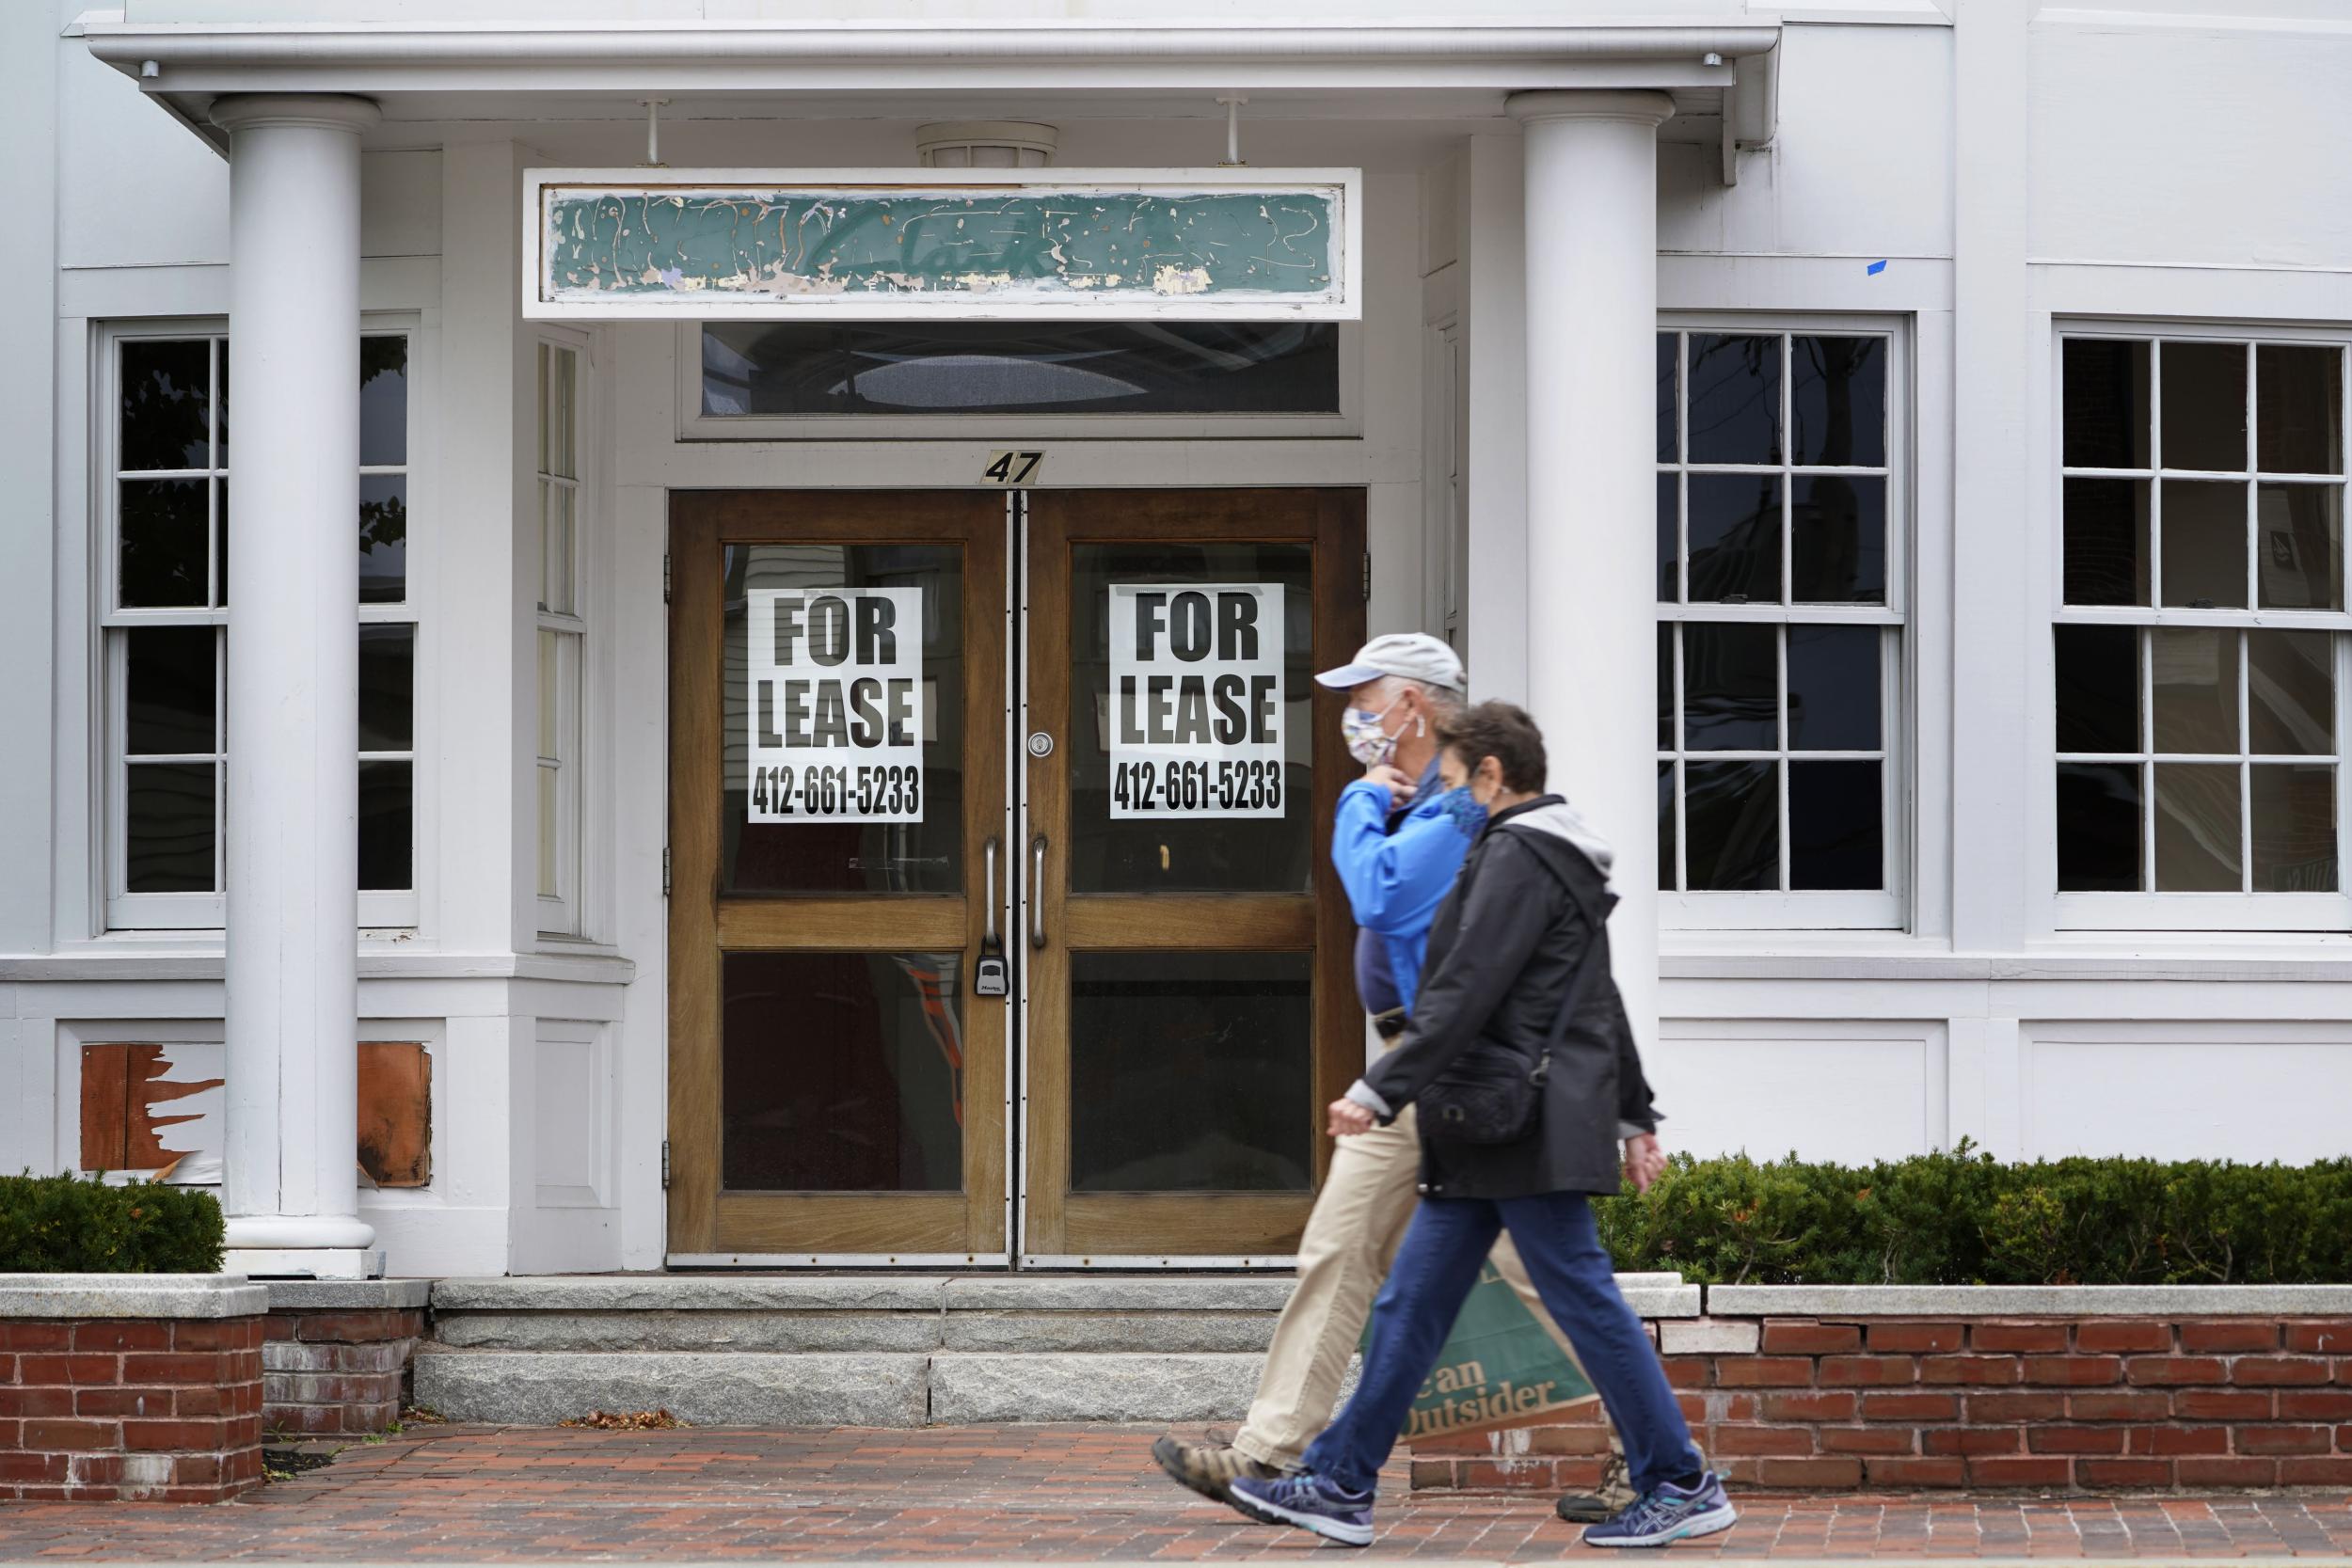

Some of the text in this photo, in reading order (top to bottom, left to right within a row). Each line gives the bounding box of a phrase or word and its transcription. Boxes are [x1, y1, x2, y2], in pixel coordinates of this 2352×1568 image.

[985, 452, 1042, 483] 47
[773, 595, 897, 666] FOR
[1135, 591, 1259, 662] FOR
[757, 677, 914, 749] LEASE
[1120, 673, 1277, 745] LEASE
[753, 765, 919, 816] 412-661-5233
[1114, 759, 1281, 811] 412-661-5233
